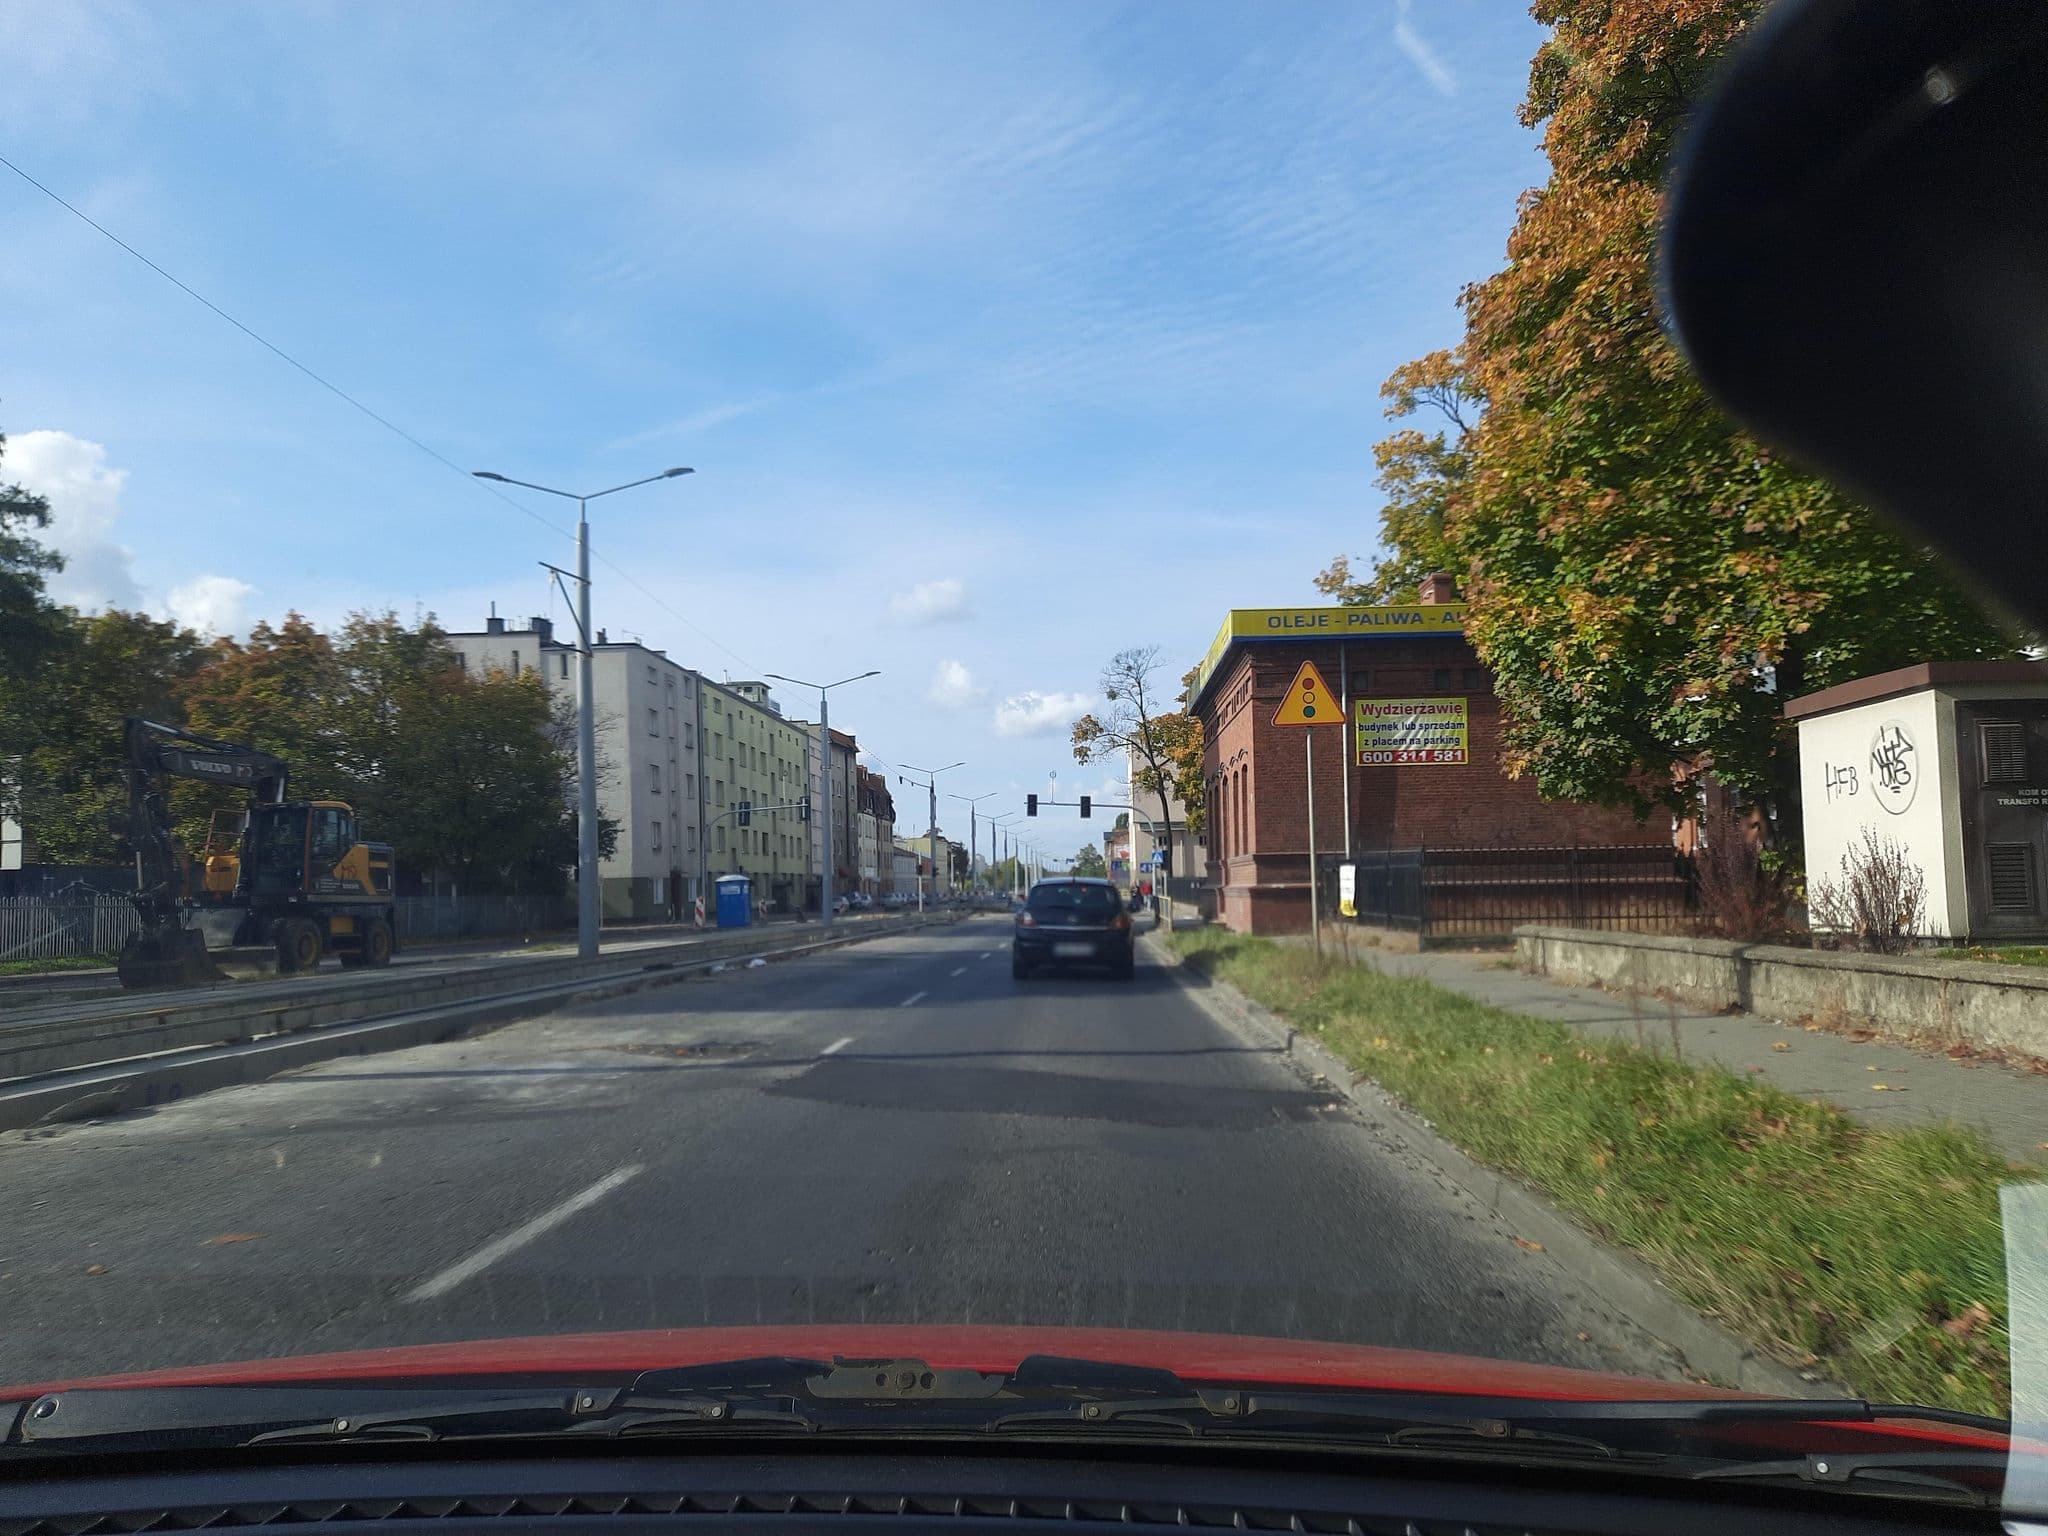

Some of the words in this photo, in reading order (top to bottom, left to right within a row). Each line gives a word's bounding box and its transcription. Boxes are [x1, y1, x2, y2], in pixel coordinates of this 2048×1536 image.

[1267, 614, 1329, 628] OLEJE
[1347, 612, 1424, 626] PALIWA
[1360, 702, 1463, 718] Wydzierżawię
[1358, 722, 1399, 733] budynek
[1401, 721, 1417, 731] lub
[1419, 720, 1465, 732] sprzedam
[1372, 737, 1407, 747] placem
[1423, 735, 1461, 747] parking
[1362, 751, 1394, 763] 600
[1398, 750, 1429, 762] 311
[1433, 750, 1463, 761] 581
